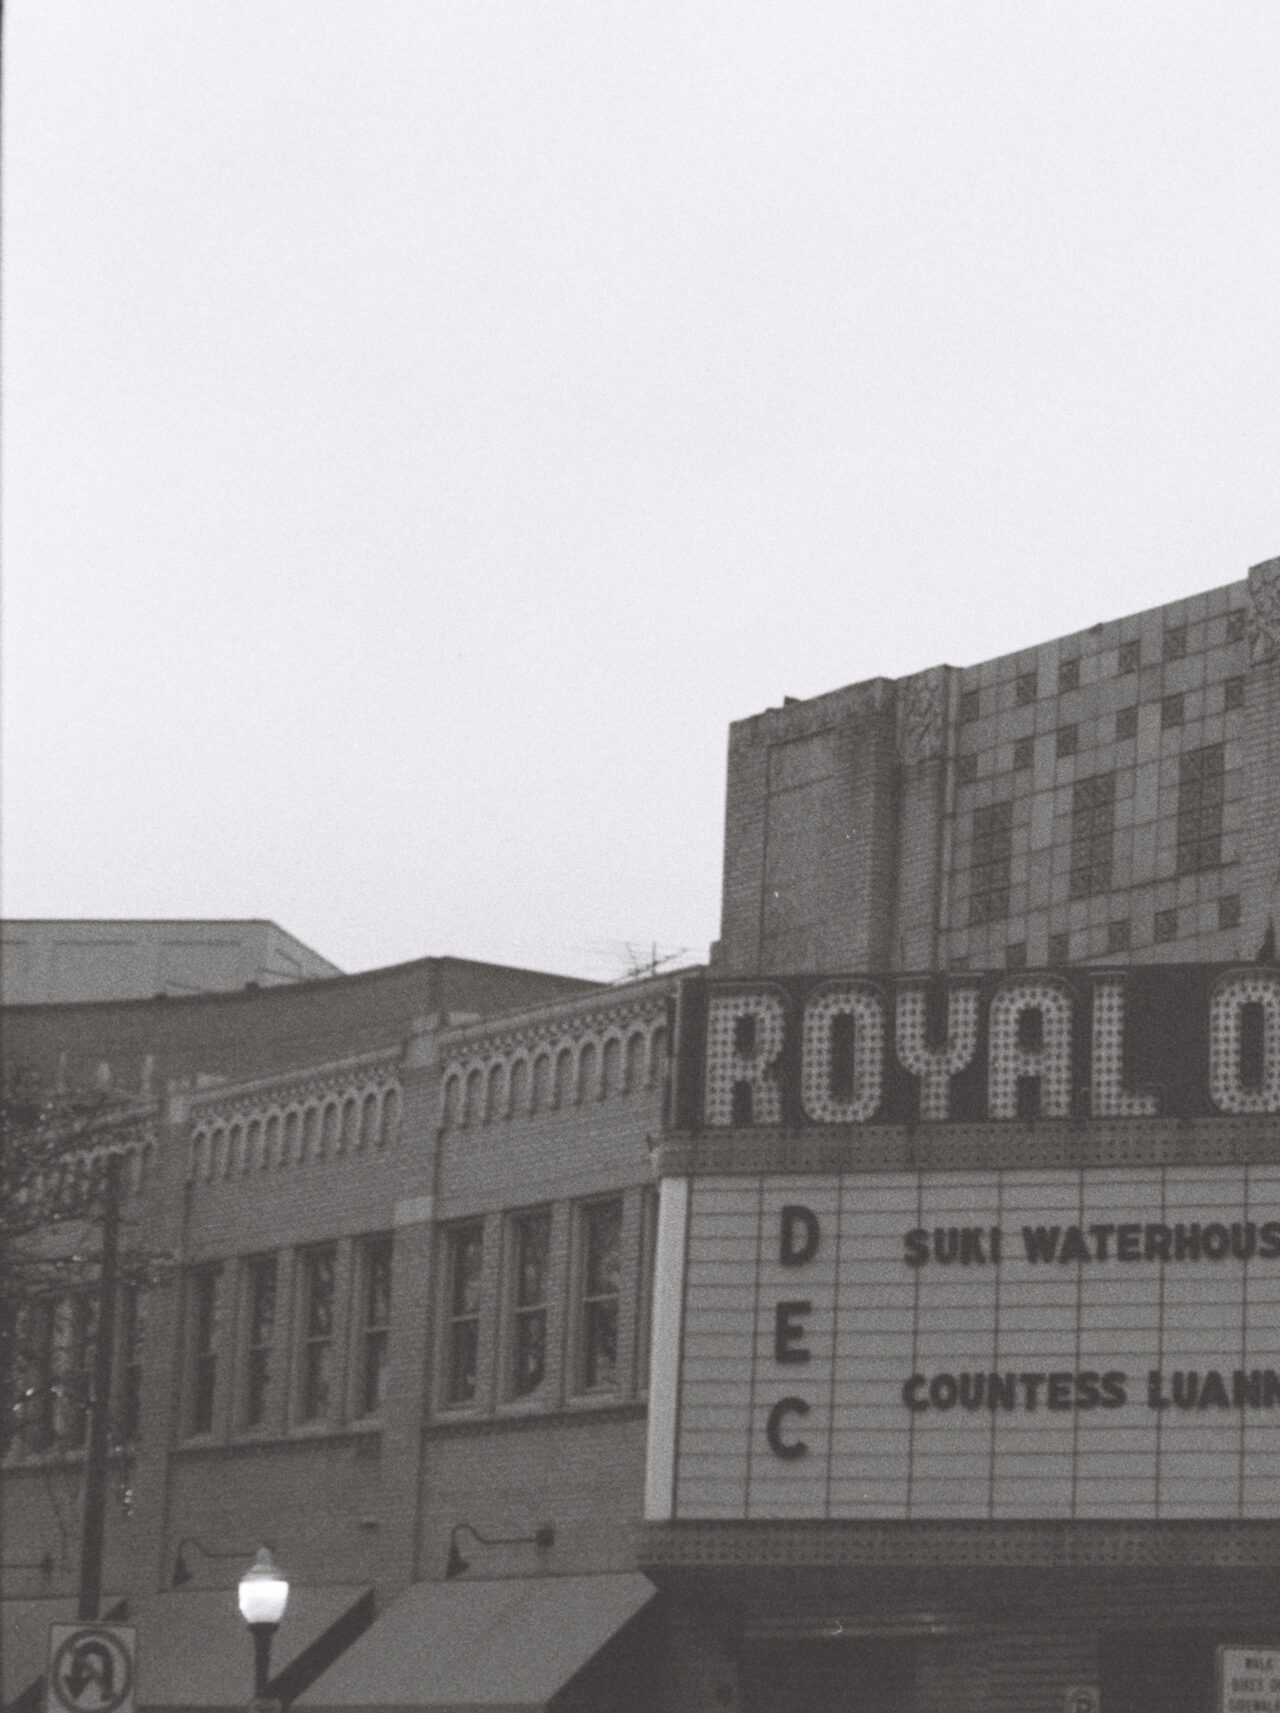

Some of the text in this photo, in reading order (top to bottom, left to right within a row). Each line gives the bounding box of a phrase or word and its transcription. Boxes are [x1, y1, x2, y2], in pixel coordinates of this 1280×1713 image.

[704, 984, 1158, 1126] ROYAL
[903, 1225, 1001, 1269] SUKI
[902, 1371, 1127, 1412] COUNTESS
